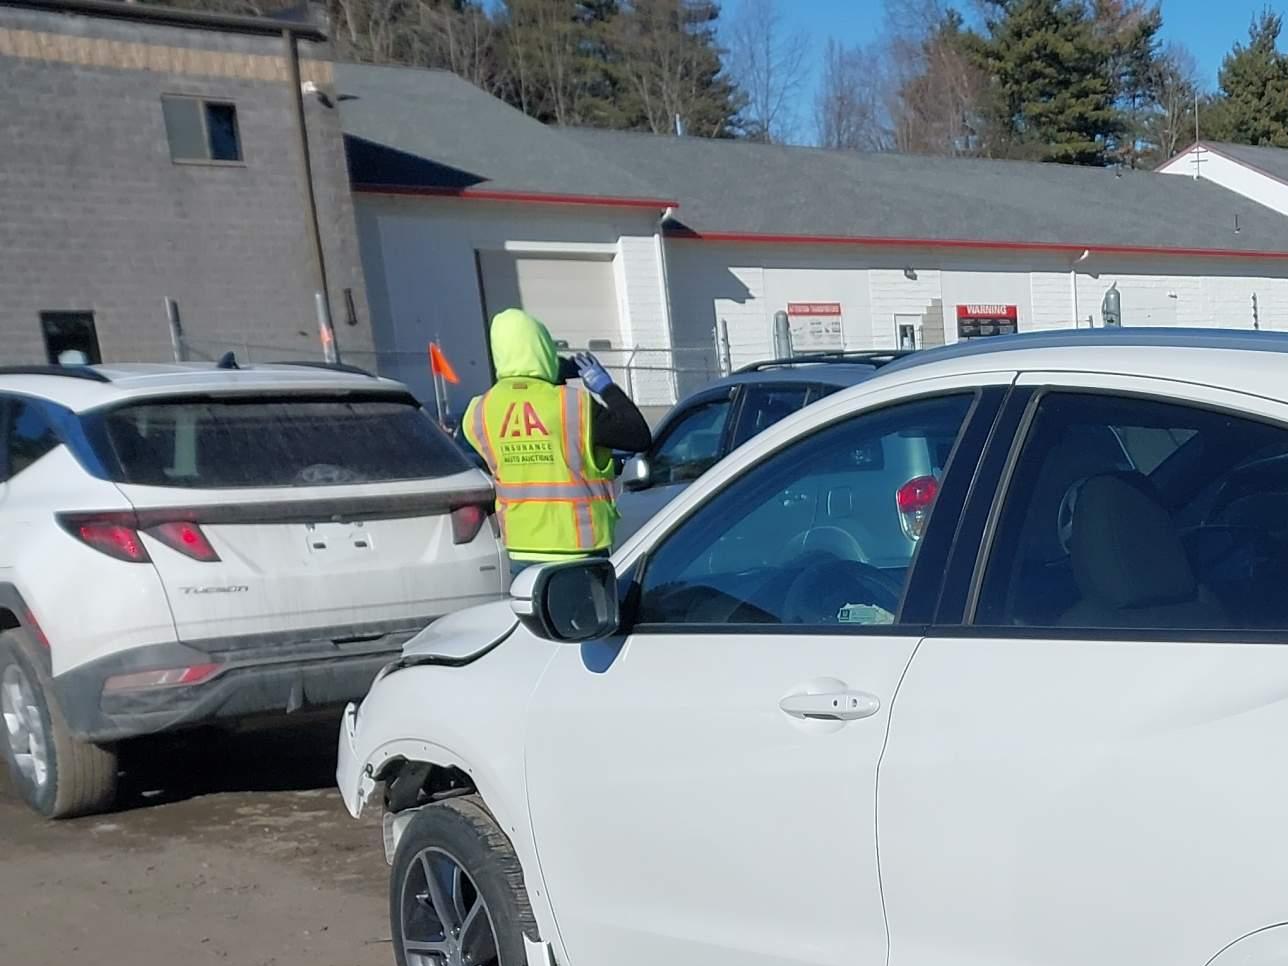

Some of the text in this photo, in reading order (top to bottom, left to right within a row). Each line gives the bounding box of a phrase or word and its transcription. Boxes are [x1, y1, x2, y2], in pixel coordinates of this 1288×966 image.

[966, 304, 1007, 314] WARNING
[500, 443, 553, 452] INSURANCE
[521, 454, 555, 462] AUCTIONS
